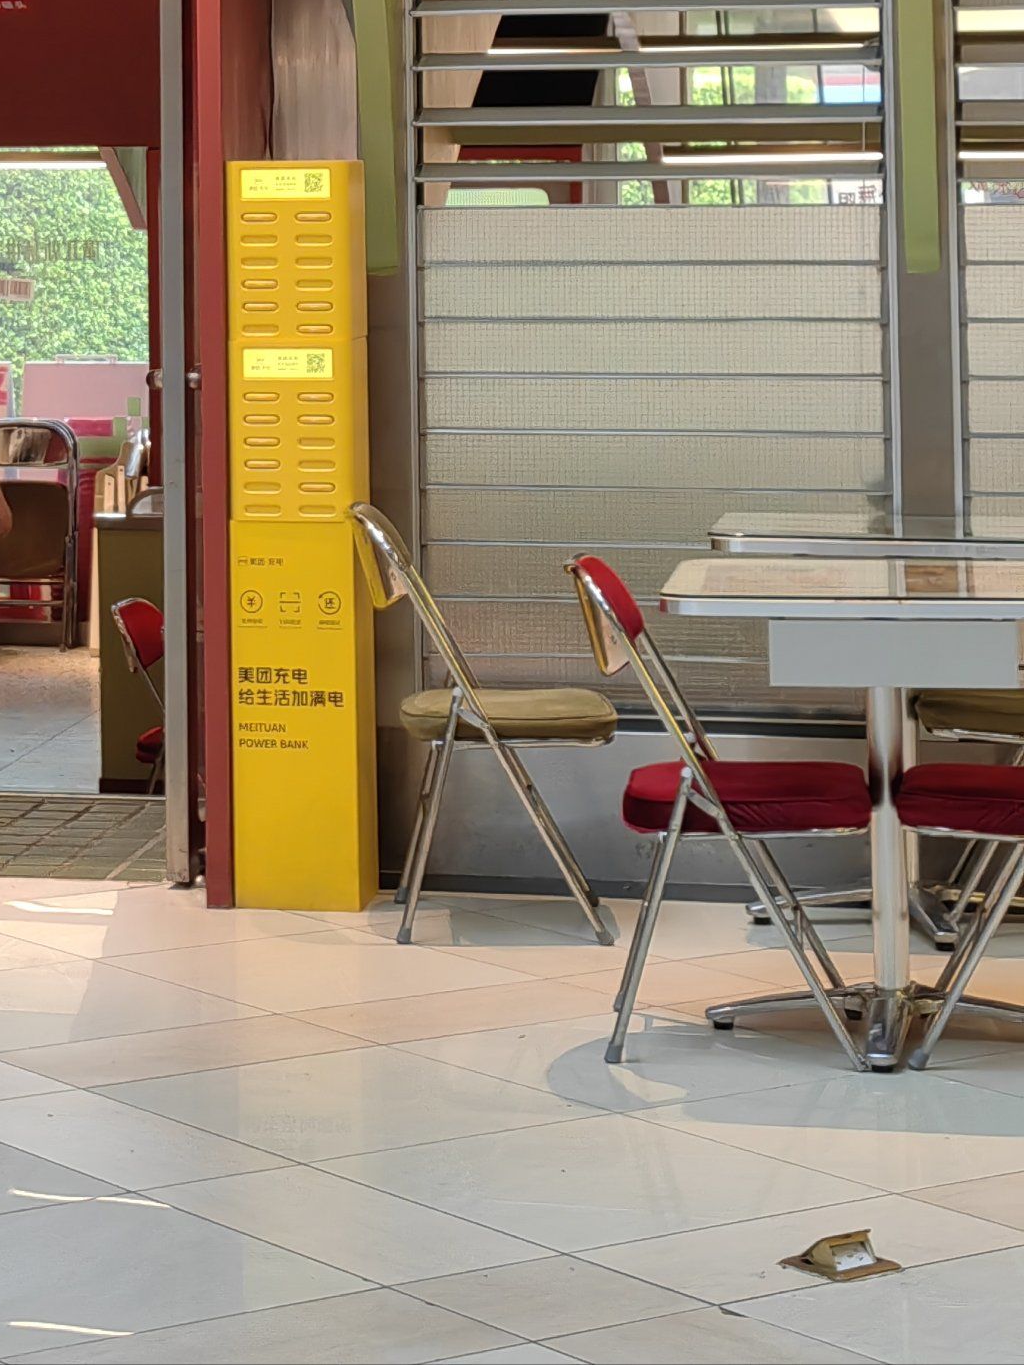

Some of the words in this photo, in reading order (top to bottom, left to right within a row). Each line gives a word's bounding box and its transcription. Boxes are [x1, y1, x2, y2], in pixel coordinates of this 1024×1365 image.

[238, 667, 308, 684] 美团充电
[238, 688, 345, 708] 给生活加满电
[238, 723, 287, 733] MEITUAN
[239, 738, 277, 749] POWER
[280, 739, 309, 749] BANK
